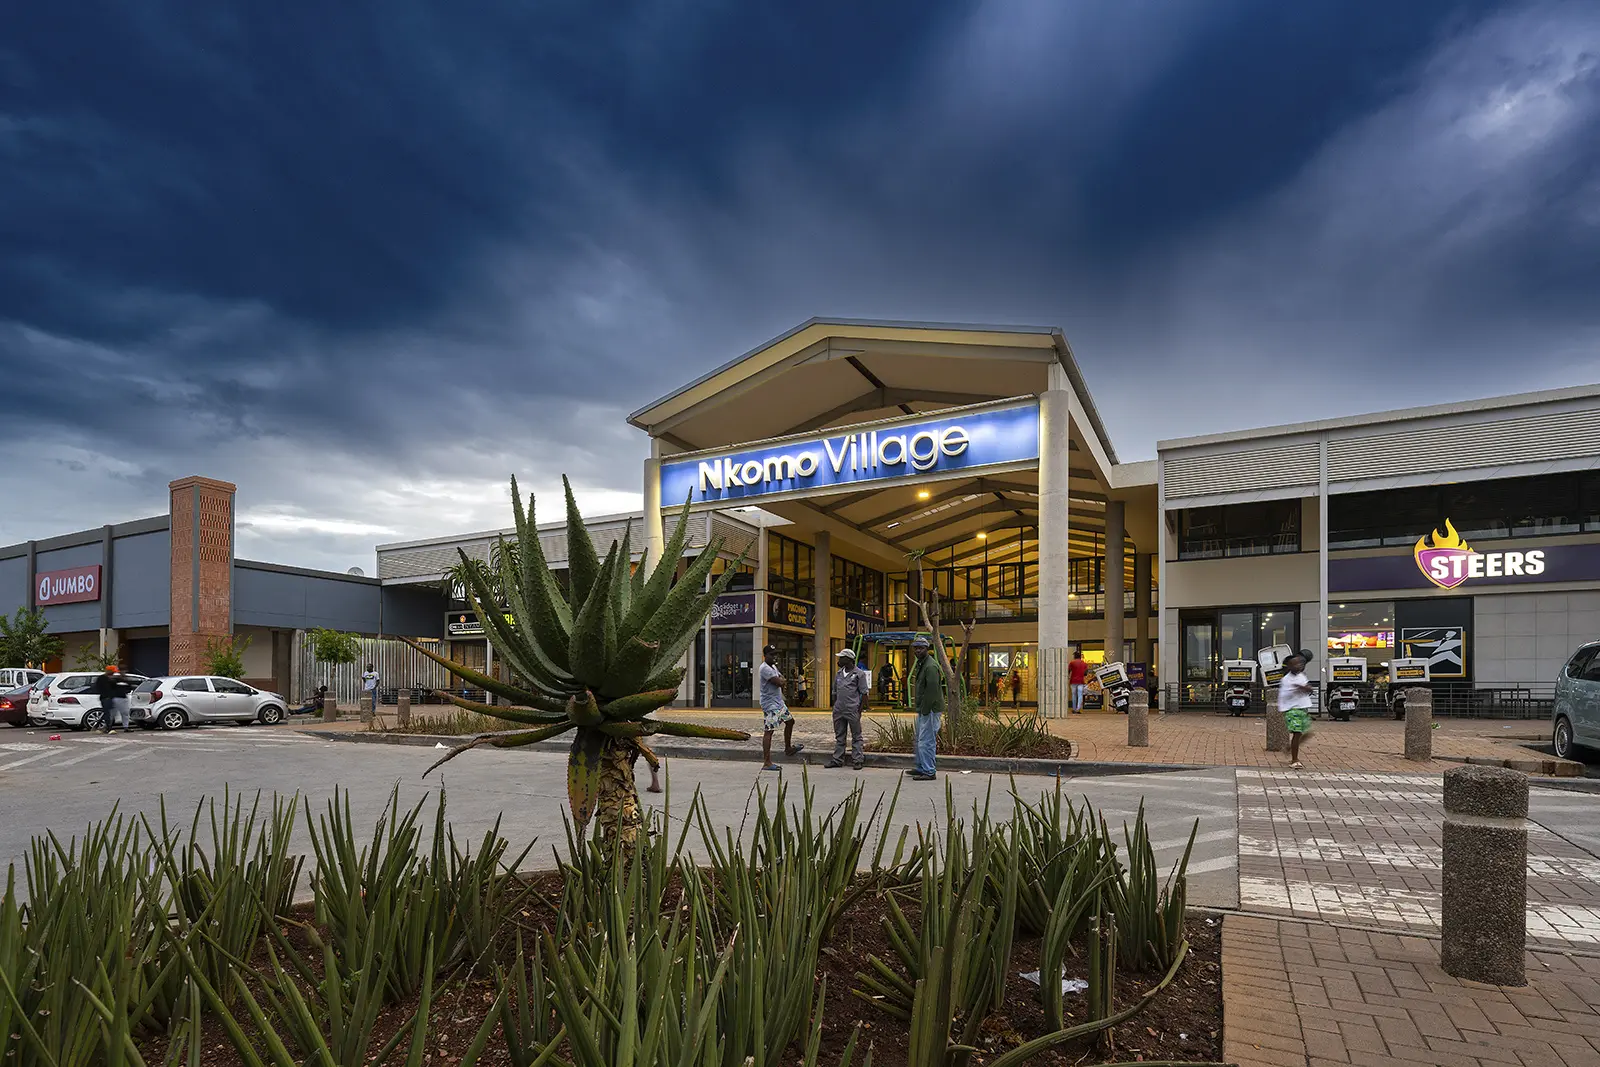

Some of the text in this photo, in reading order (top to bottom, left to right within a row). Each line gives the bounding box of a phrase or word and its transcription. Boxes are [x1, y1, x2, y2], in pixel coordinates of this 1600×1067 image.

[699, 425, 970, 492] Nkomo Village
[1430, 550, 1545, 579] STEERS
[52, 574, 94, 596] JUMBO
